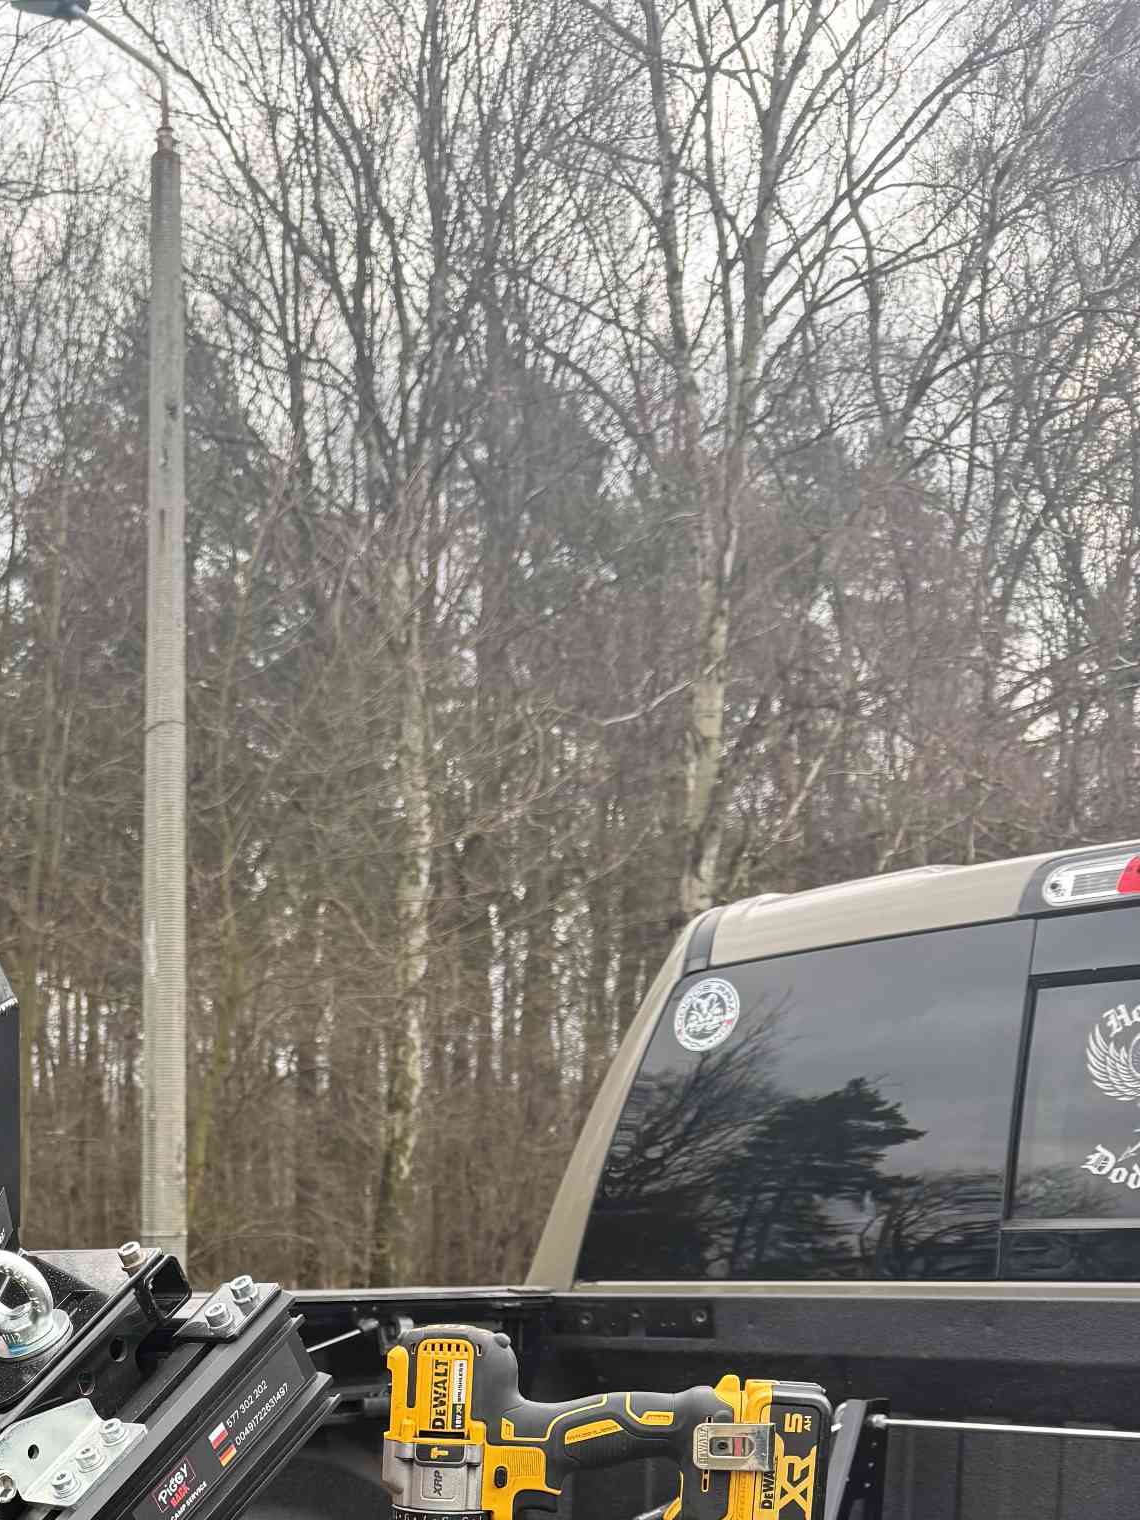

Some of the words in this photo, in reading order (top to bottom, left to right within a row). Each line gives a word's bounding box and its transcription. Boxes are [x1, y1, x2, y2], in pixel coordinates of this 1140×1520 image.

[226, 1409, 240, 1428] 577
[239, 1395, 254, 1414] 302
[253, 1380, 268, 1399] 202
[784, 1412, 803, 1433] 5
[185, 1481, 207, 1507] SERVICE
[762, 1471, 775, 1510] DEWA
